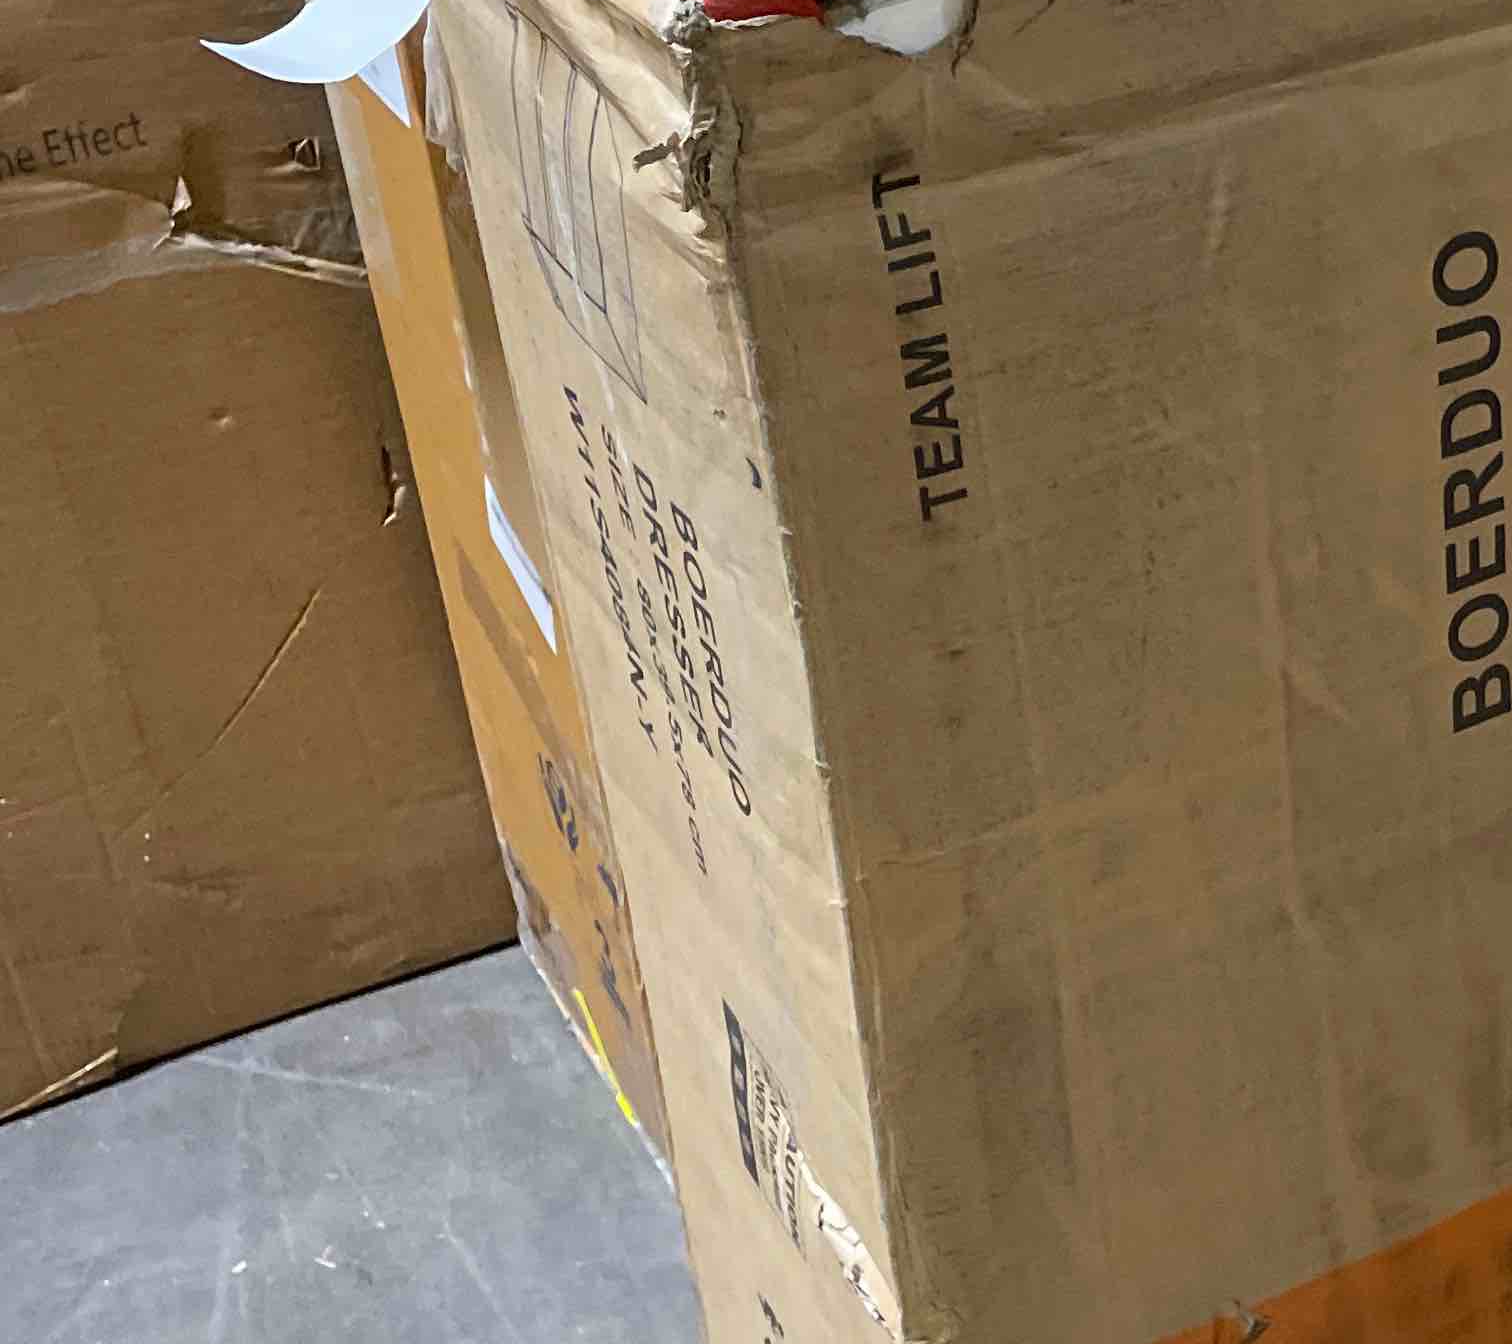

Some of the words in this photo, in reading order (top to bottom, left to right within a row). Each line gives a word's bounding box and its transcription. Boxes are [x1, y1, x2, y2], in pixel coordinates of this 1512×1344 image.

[42, 111, 148, 168] Effect
[872, 172, 944, 316] LIFT
[600, 423, 637, 541] SIZE
[900, 332, 969, 521] TEAM
[1432, 229, 1512, 735] BOERDUO
[632, 461, 717, 758] DRESSER
[669, 500, 752, 817] BOERDUO
